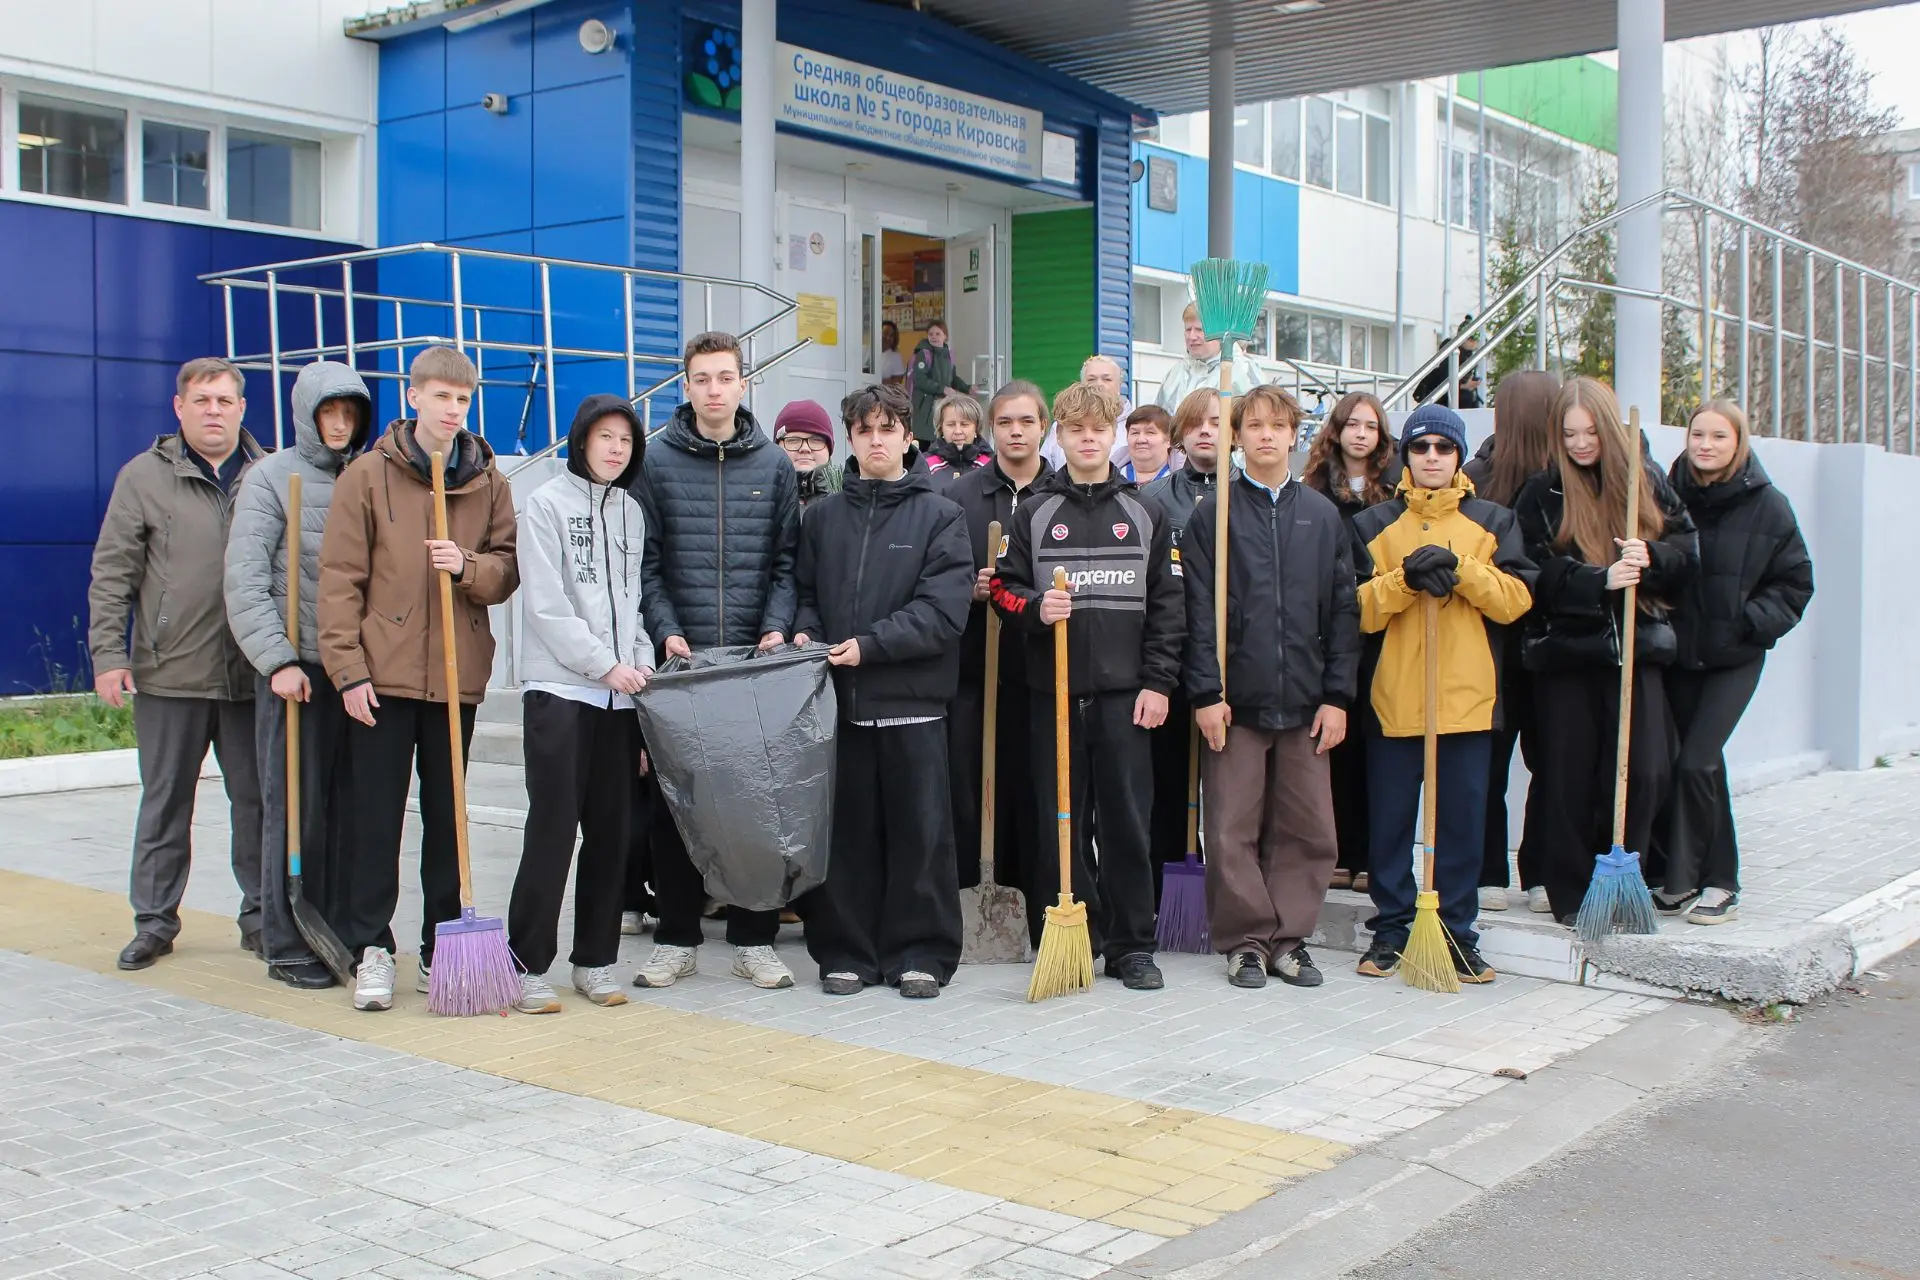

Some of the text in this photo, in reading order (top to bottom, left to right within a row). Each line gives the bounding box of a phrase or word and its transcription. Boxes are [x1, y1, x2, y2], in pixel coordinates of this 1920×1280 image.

[793, 53, 1027, 130] Средняя общеобразовательная
[783, 103, 853, 130] Муниципальное
[794, 83, 1027, 154] школа № 5 города Кировска
[1051, 565, 1136, 593] upreme
